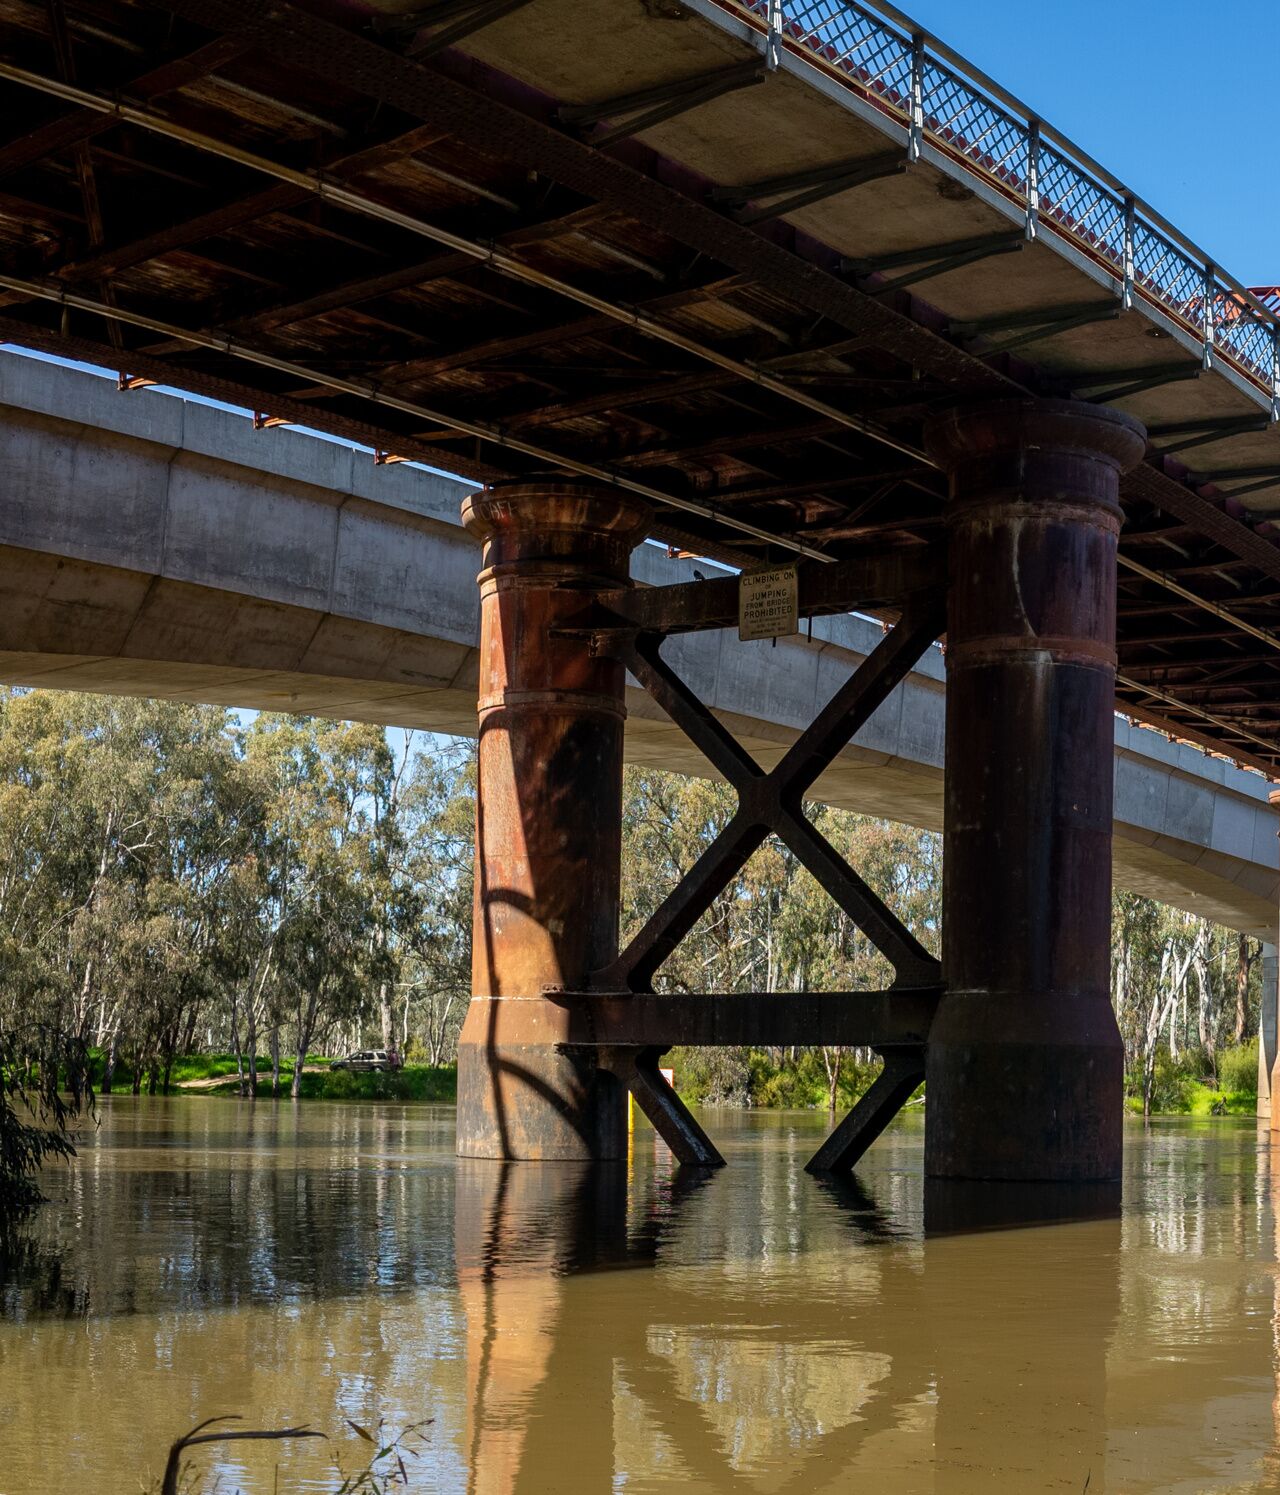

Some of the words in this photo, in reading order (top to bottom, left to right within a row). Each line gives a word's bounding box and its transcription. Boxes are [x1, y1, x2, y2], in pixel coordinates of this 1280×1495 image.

[743, 574, 780, 586] CLIMBING
[783, 571, 794, 580] ON
[750, 589, 787, 601] JUMPING
[745, 602, 764, 611] FROM
[766, 597, 790, 606] BRIDGE
[744, 605, 793, 619] PROHIBITED
